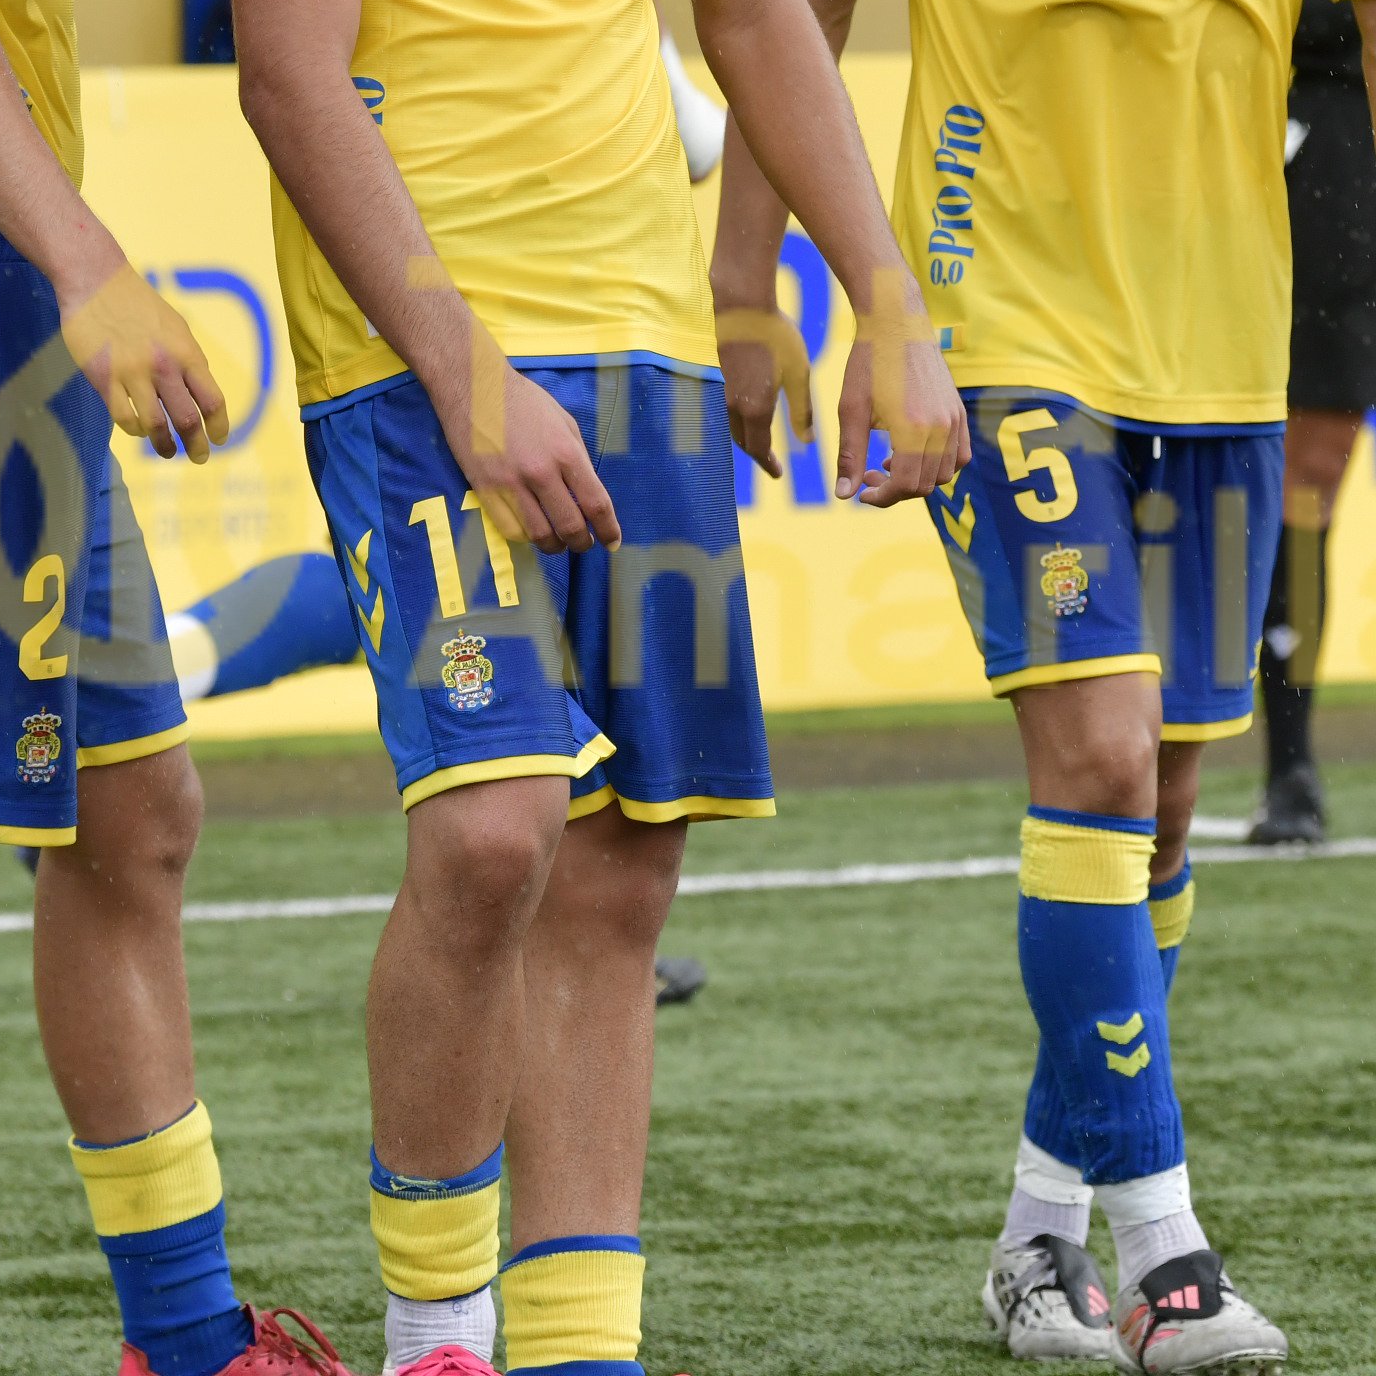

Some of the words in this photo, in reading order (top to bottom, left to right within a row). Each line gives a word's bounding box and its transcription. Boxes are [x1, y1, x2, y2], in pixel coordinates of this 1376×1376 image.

[997, 407, 1079, 523] 5
[18, 554, 69, 681] 2
[408, 489, 521, 619] 11
